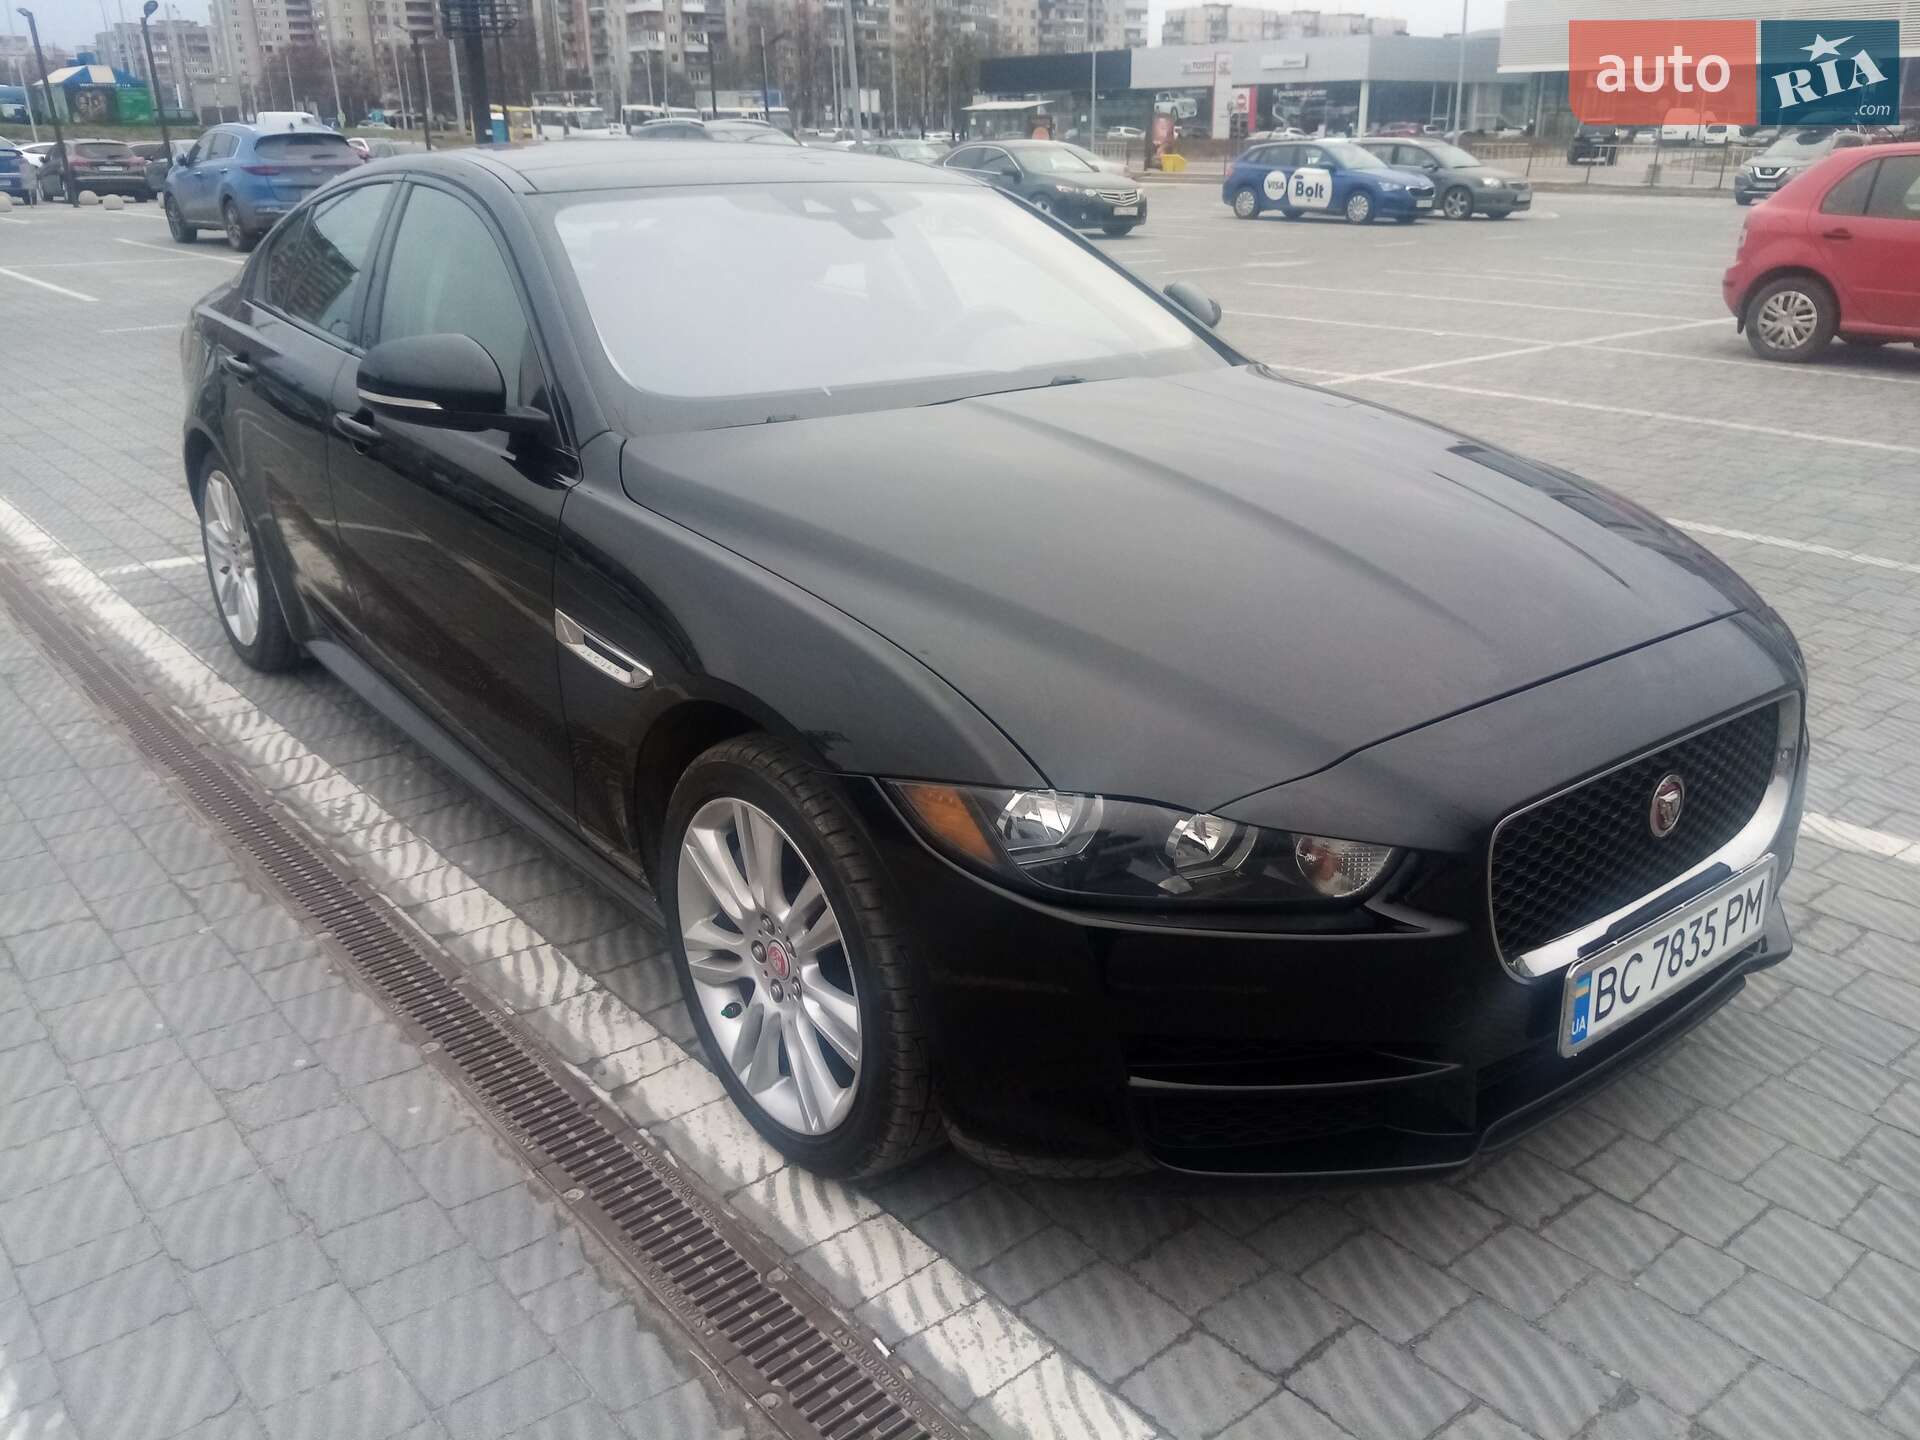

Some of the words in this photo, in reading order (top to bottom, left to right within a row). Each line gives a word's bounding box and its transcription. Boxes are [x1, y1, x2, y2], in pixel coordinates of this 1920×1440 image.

[1267, 179, 1284, 190] VISA
[1295, 181, 1324, 199] Bolt
[1594, 952, 1643, 1023] BC
[1651, 908, 1718, 990] 7835
[1722, 879, 1765, 946] PM
[1571, 1015, 1586, 1036] UA
